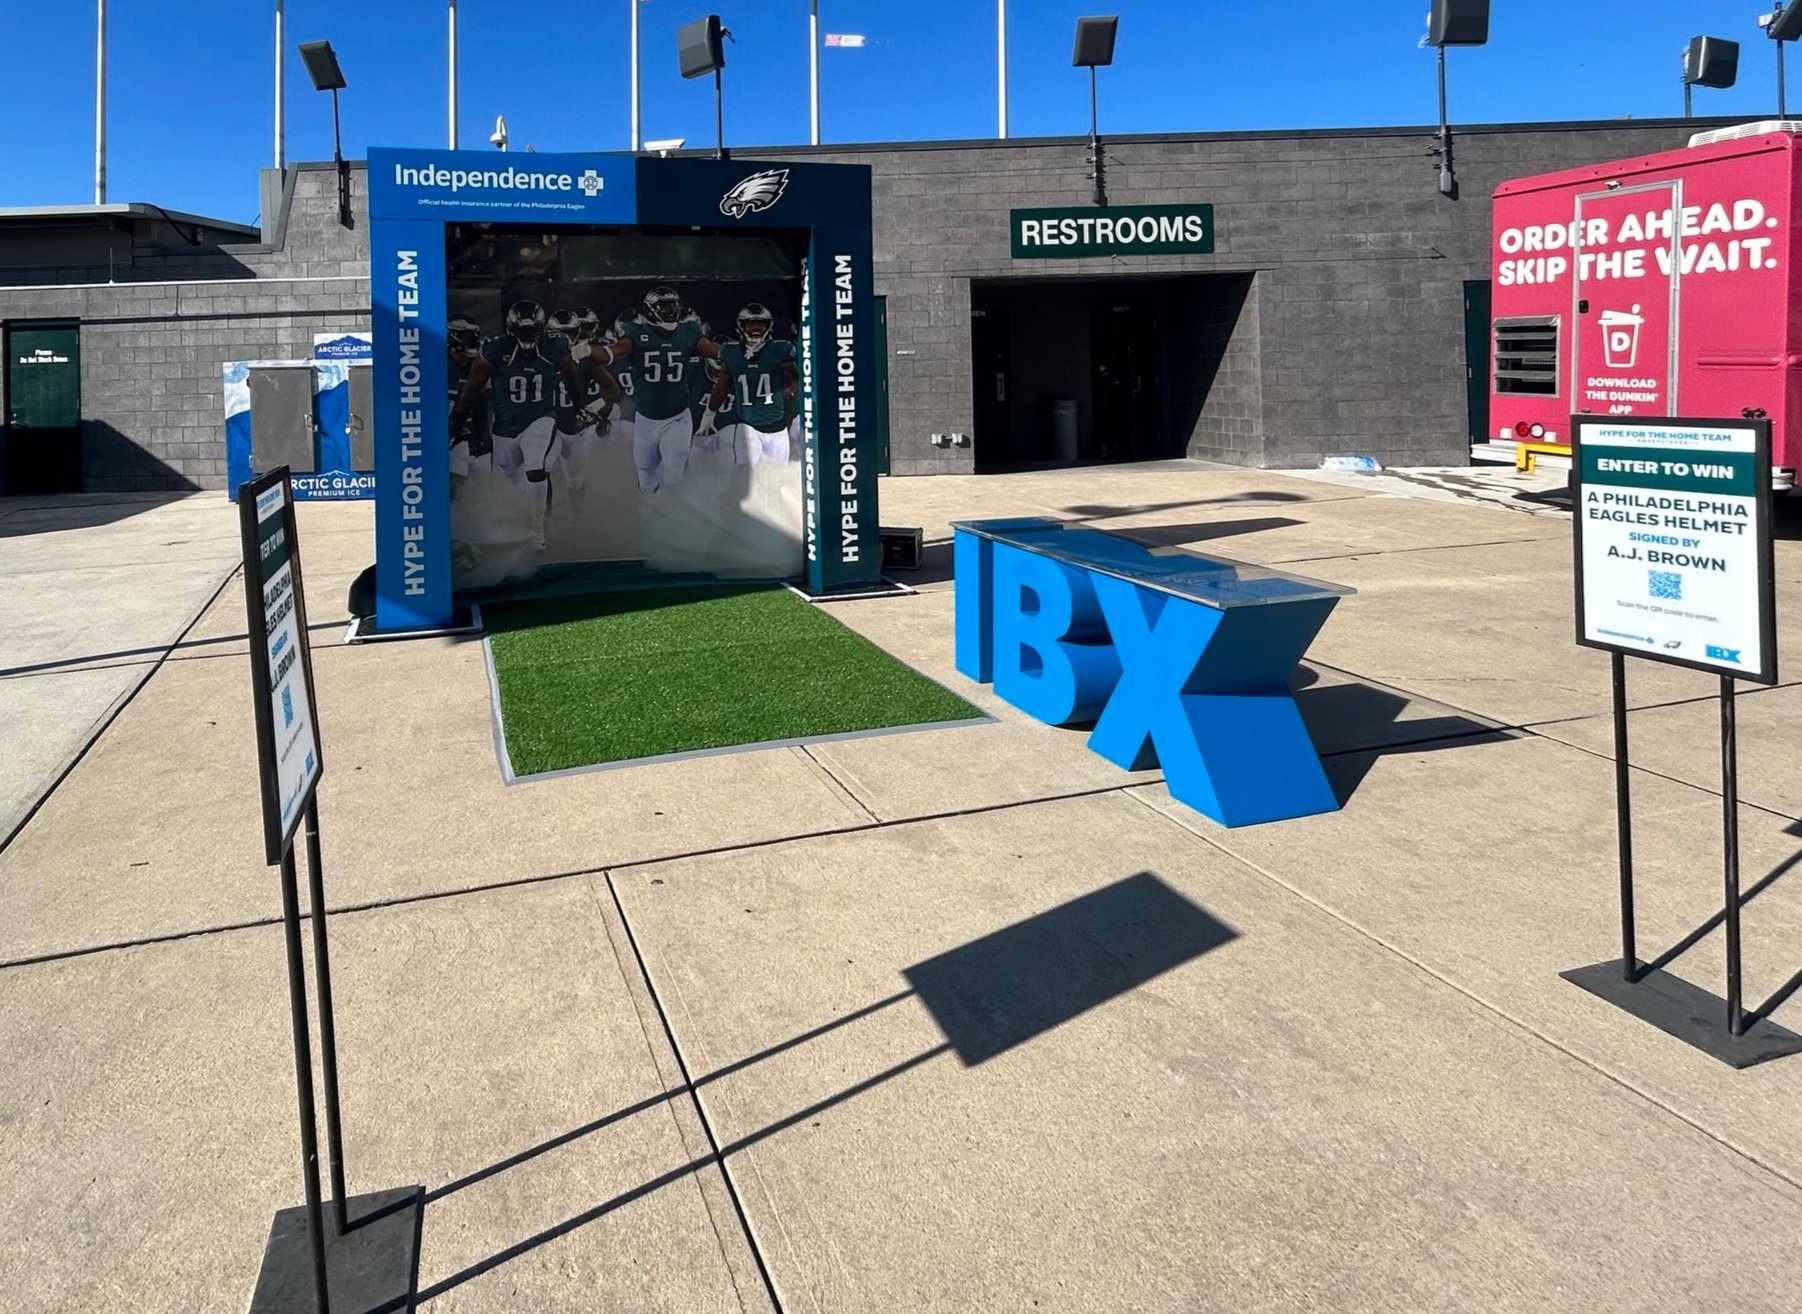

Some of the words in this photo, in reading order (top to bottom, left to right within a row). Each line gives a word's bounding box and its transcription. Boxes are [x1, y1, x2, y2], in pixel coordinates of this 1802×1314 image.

[394, 164, 572, 192] Independence
[1021, 215, 1203, 246] RESTROOMS
[1499, 218, 1608, 254] ORDER
[1616, 199, 1778, 243] AHEAD.
[1498, 256, 1567, 286] SKIP
[1578, 249, 1646, 281] THE
[1654, 237, 1777, 275] WAIT.
[397, 250, 419, 322] TEAM
[834, 255, 853, 320] TEAM
[802, 325, 812, 393] HOME
[836, 324, 855, 392] HOME
[1611, 331, 1631, 352] D
[399, 328, 421, 404] HOME
[643, 351, 683, 382] 55
[1587, 377, 1656, 388] DOWNLOAD
[509, 374, 544, 403] 91
[738, 373, 774, 406] 14
[1585, 390, 1608, 400] THE
[804, 397, 813, 443] THE
[838, 397, 856, 444] THE
[1608, 405, 1632, 414] APP
[401, 410, 422, 462] THE
[1599, 429, 1625, 438] HYPE
[1648, 431, 1668, 439] THE
[1669, 432, 1700, 441] HOME
[1701, 433, 1732, 442] TEAM
[291, 478, 329, 490] RCTIC
[332, 477, 376, 489] GLACI
[806, 447, 815, 495] FOR
[840, 448, 857, 495] FOR
[1597, 458, 1658, 474] ENTER
[1660, 462, 1689, 476] TO
[1691, 464, 1734, 479] WIN
[402, 467, 423, 520] FOR
[1587, 491, 1599, 503] A
[1603, 492, 1749, 517] PHILADELPHIA
[807, 498, 817, 561] HYPE
[841, 500, 859, 562] HYPE
[1589, 508, 1659, 526] EAGLES
[1664, 515, 1747, 535] HELMET
[1629, 532, 1679, 546] SIGNED
[1682, 538, 1701, 549] BY
[403, 525, 425, 595] HYPE
[1607, 545, 1643, 561] A.J.
[1647, 550, 1726, 572] BROWN
[1705, 644, 1741, 664] IBX
[954, 529, 1275, 828] IBX
